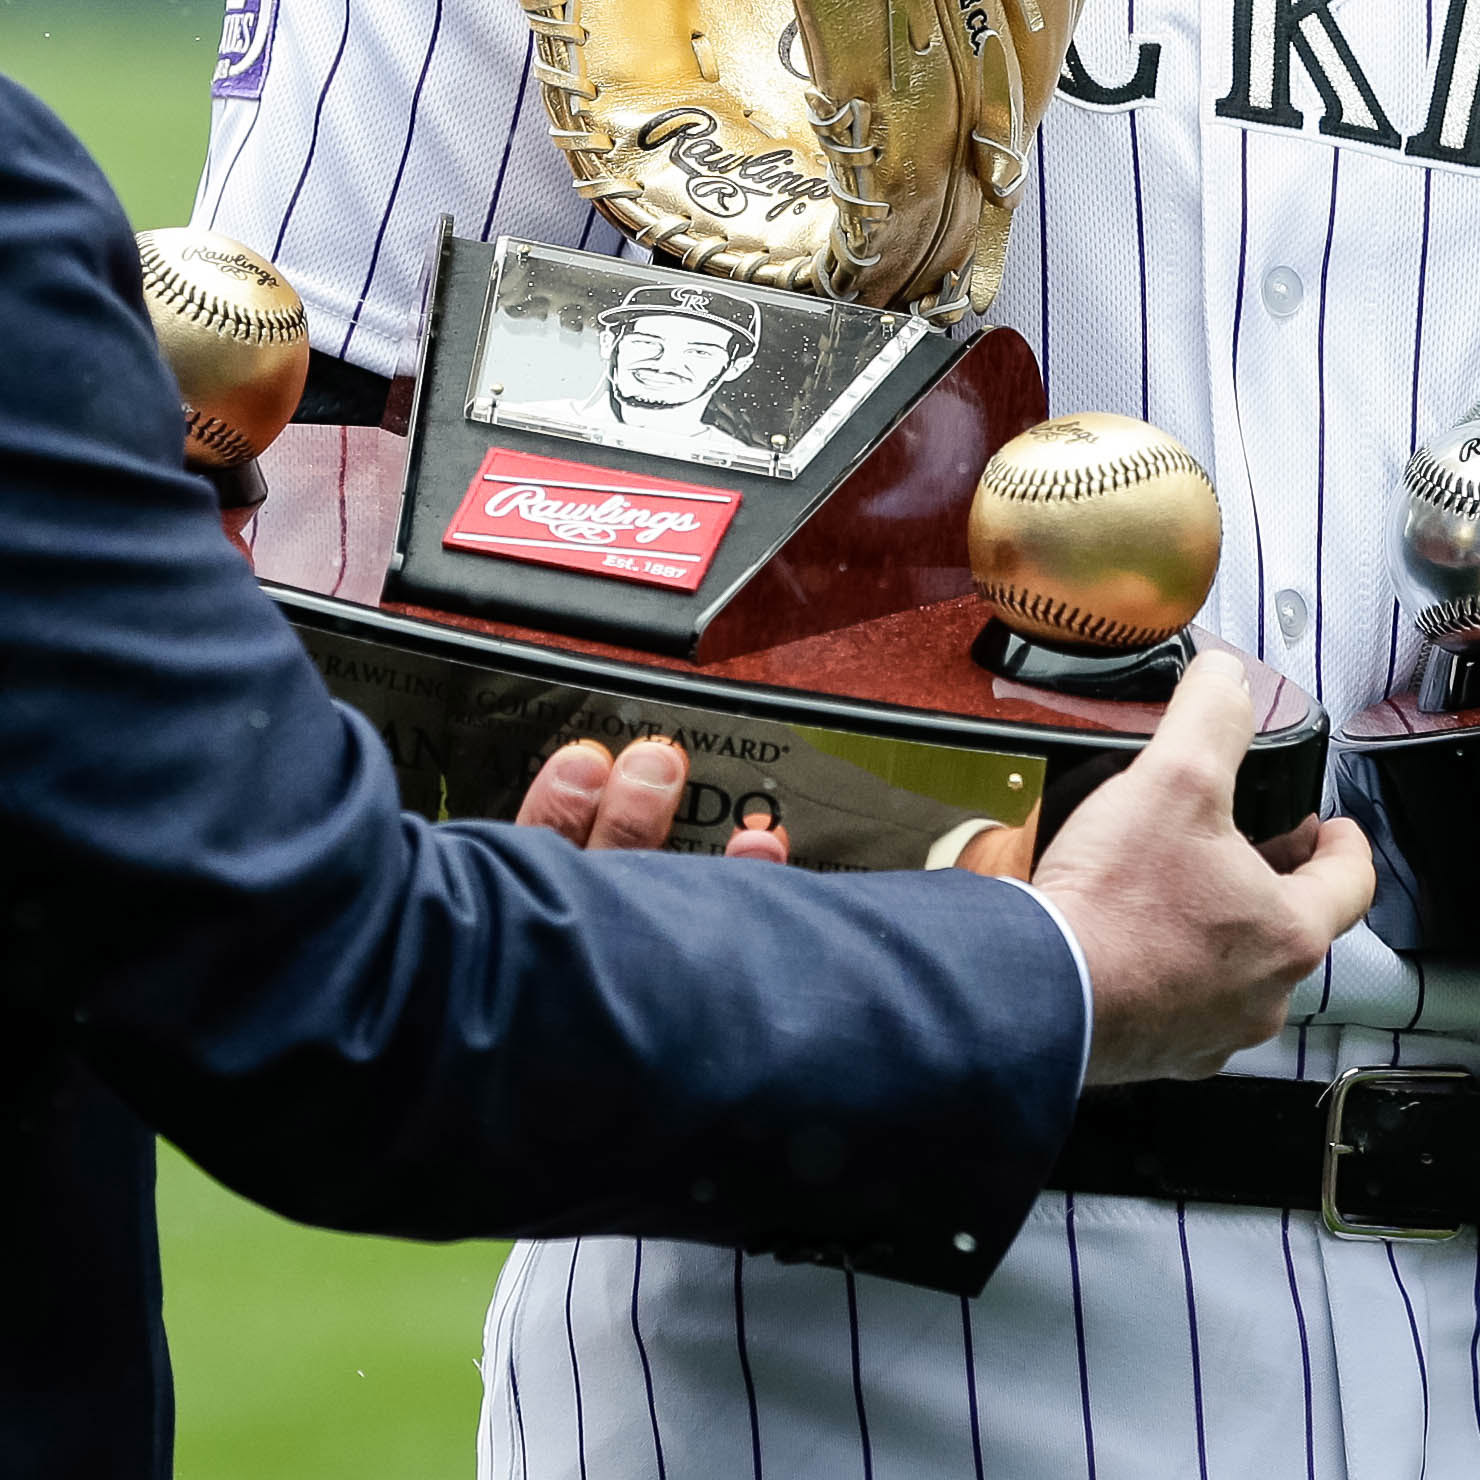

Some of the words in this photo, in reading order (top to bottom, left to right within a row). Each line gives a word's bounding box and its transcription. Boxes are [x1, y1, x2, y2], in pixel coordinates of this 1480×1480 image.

[636, 107, 832, 221] Rawlings
[181, 244, 280, 288] Rawlings
[484, 485, 701, 543] Rawlings
[602, 553, 641, 574] Est.
[643, 559, 688, 579] 1887
